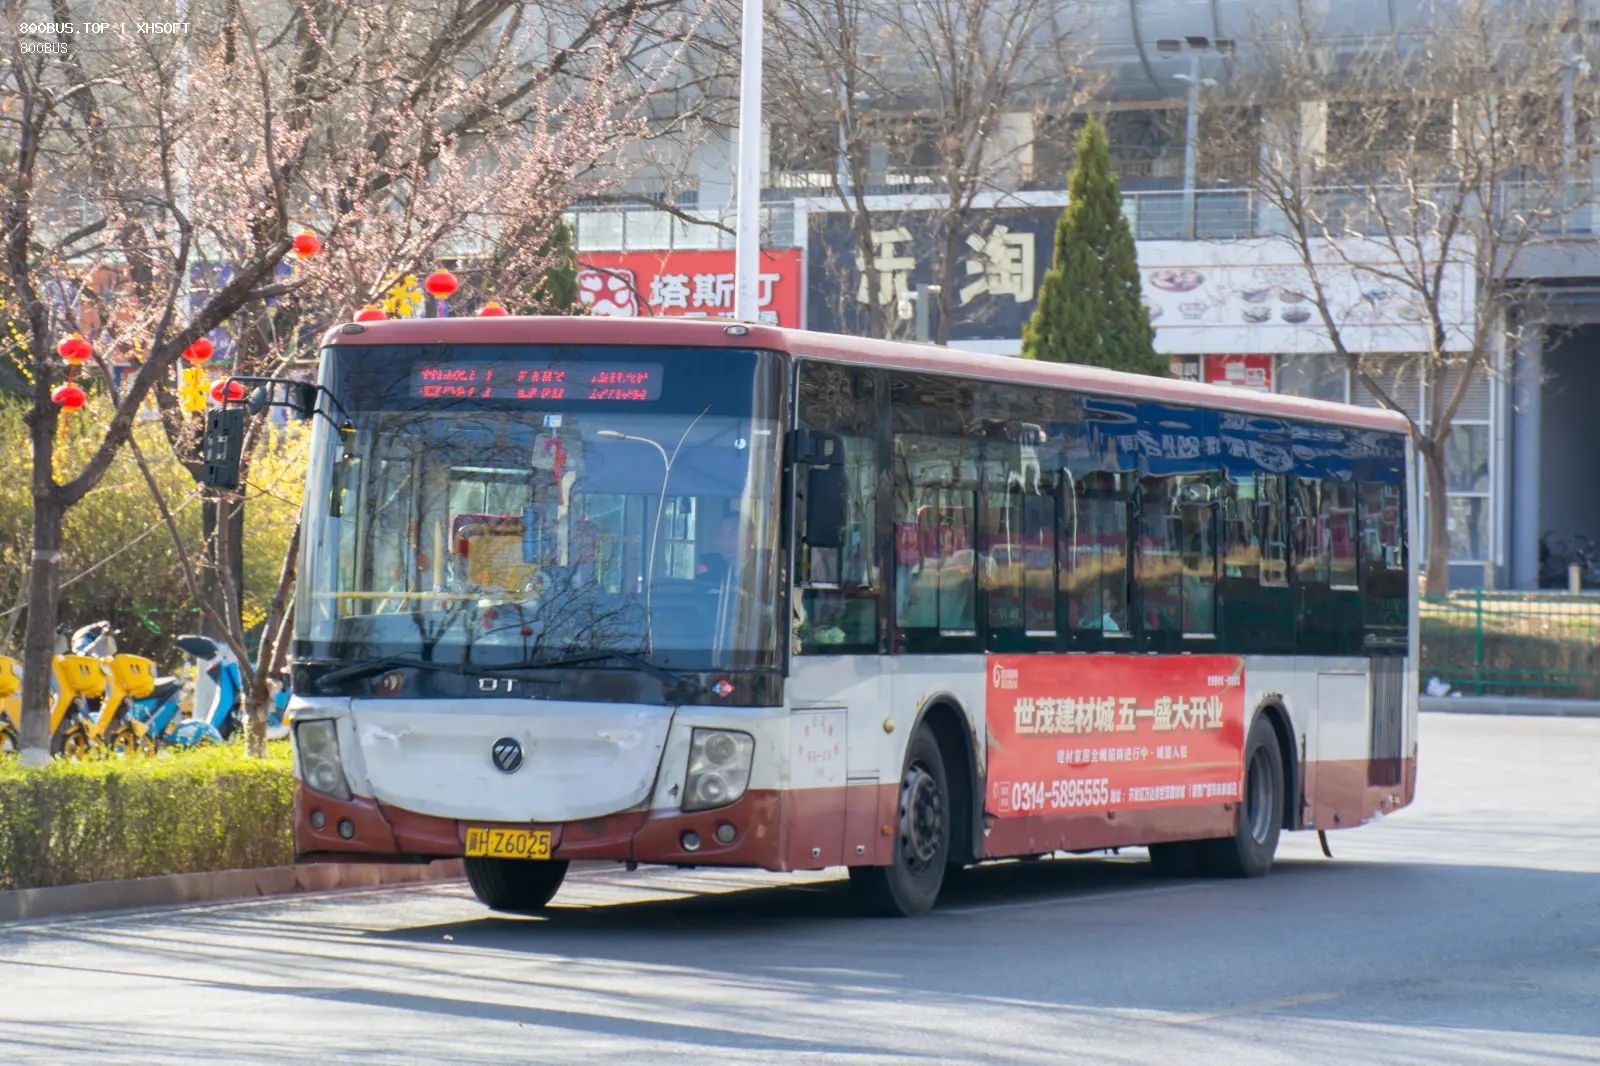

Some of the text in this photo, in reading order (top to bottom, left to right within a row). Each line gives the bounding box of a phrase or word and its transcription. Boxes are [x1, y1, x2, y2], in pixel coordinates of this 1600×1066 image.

[1014, 695, 1224, 734] 世茂建材城五一盛大开业
[1011, 778, 1109, 812] 0314-5895555
